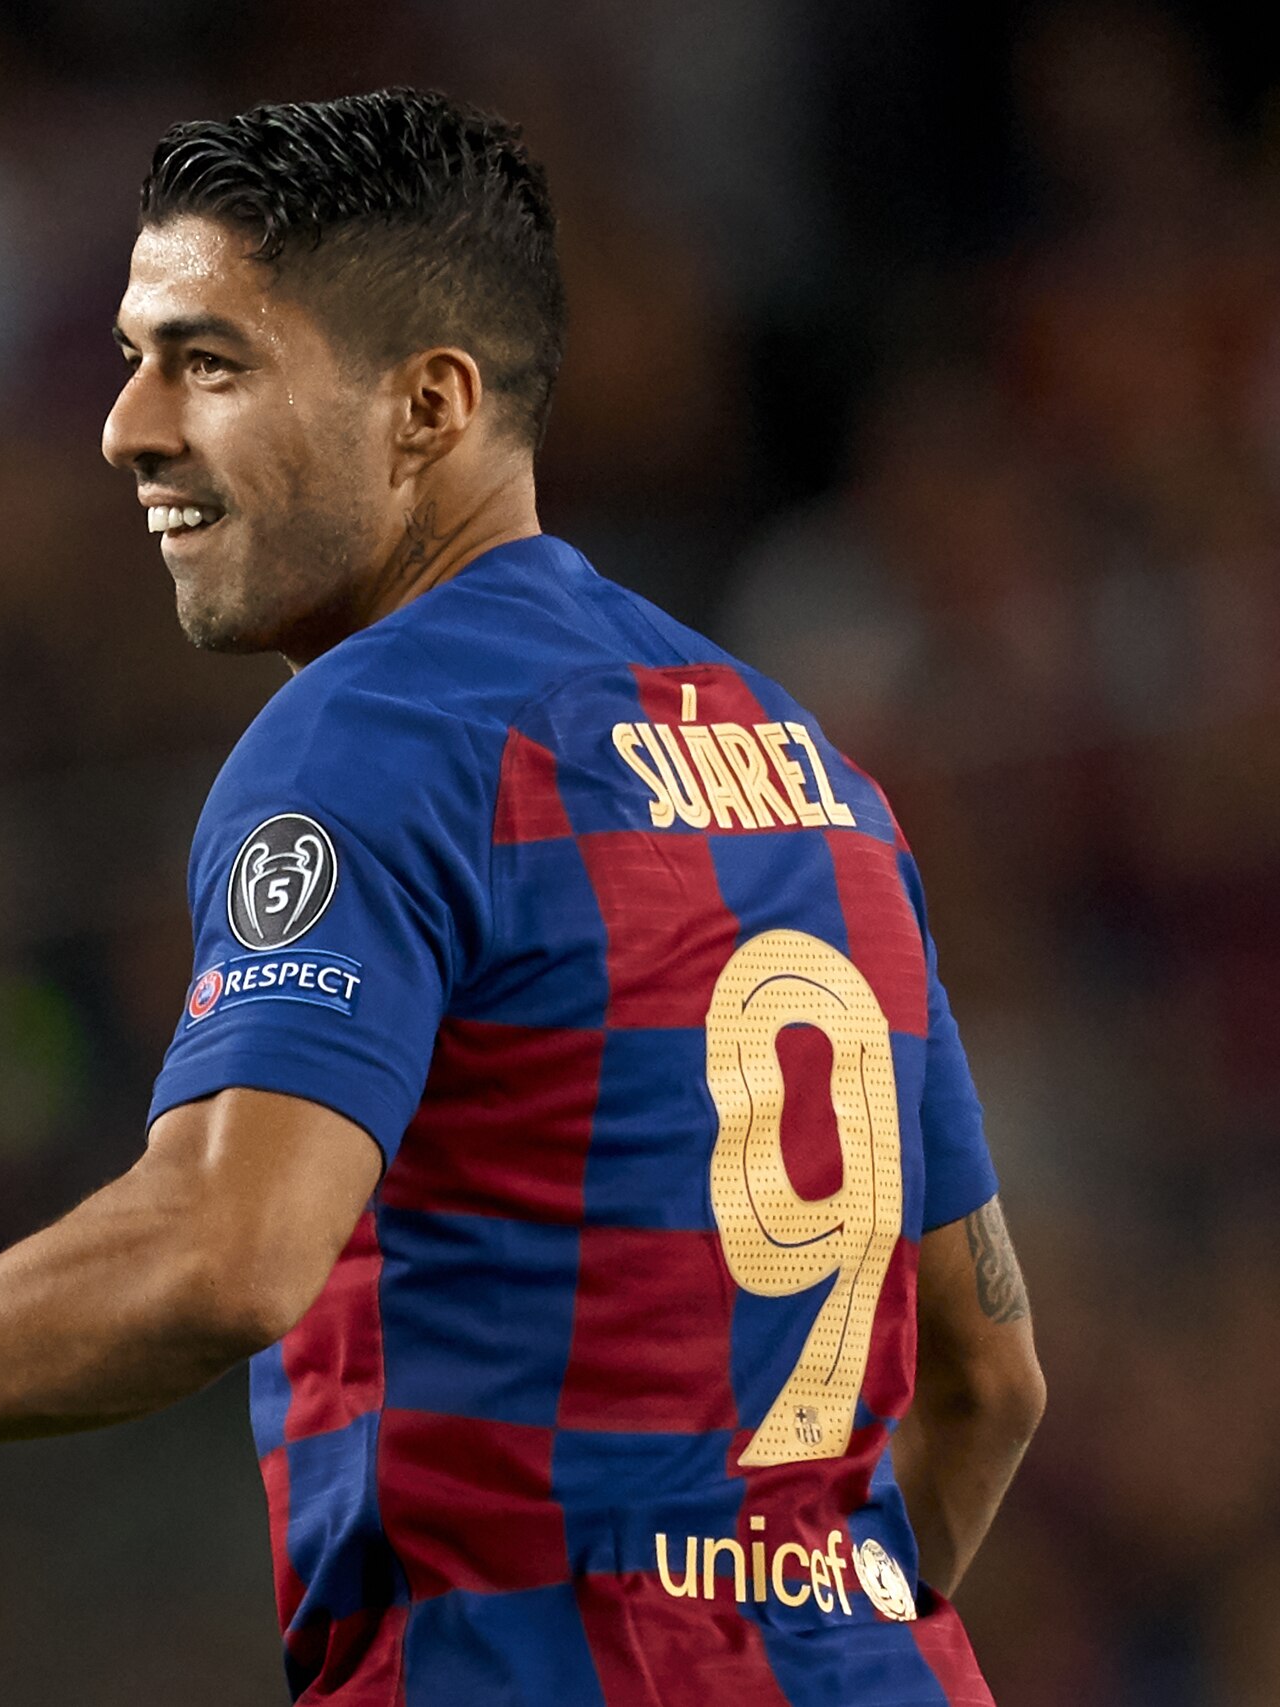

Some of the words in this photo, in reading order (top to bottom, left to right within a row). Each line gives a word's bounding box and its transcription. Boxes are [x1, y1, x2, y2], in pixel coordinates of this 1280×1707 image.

[612, 684, 856, 829] SUÁREZ
[265, 877, 290, 914] 5
[224, 963, 361, 1000] RESPECT
[705, 929, 903, 1467] 9
[655, 1516, 852, 1616] unicef
